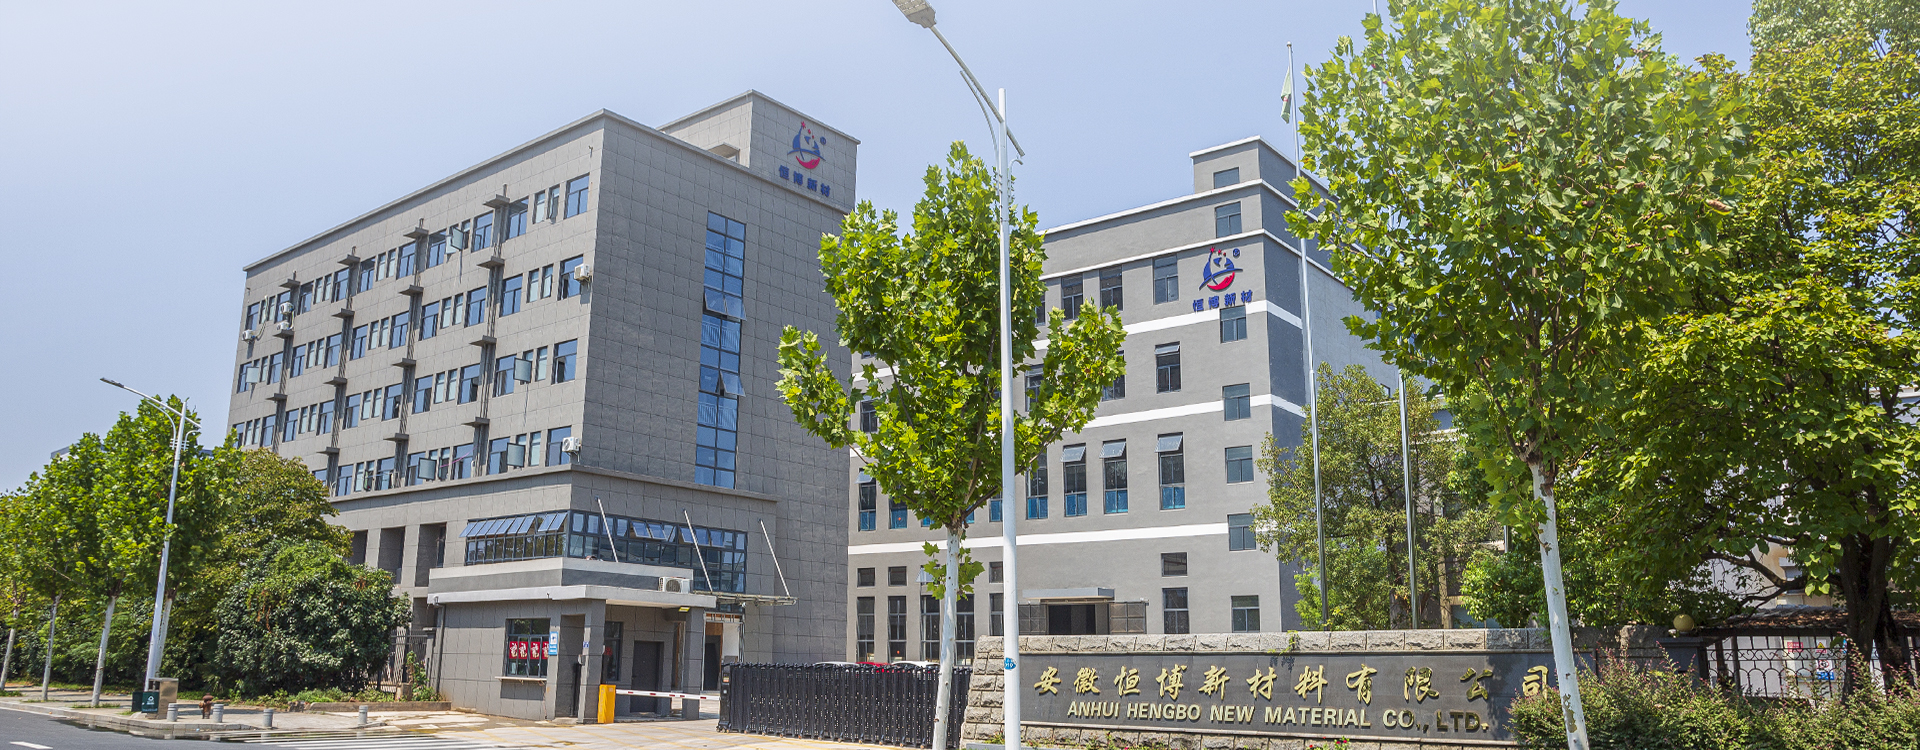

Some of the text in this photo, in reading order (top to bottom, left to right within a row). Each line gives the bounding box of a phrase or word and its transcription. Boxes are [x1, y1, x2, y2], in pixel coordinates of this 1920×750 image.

[778, 164, 831, 197] 恒博新材
[1192, 289, 1253, 313] 恒博新材
[1033, 663, 1549, 705] 安徽恒博新材料有限公司
[1067, 700, 1120, 718] ANHUI
[1126, 702, 1201, 721] HENGBO
[1209, 704, 1255, 723] NEW
[1264, 706, 1372, 727] MATERIAL
